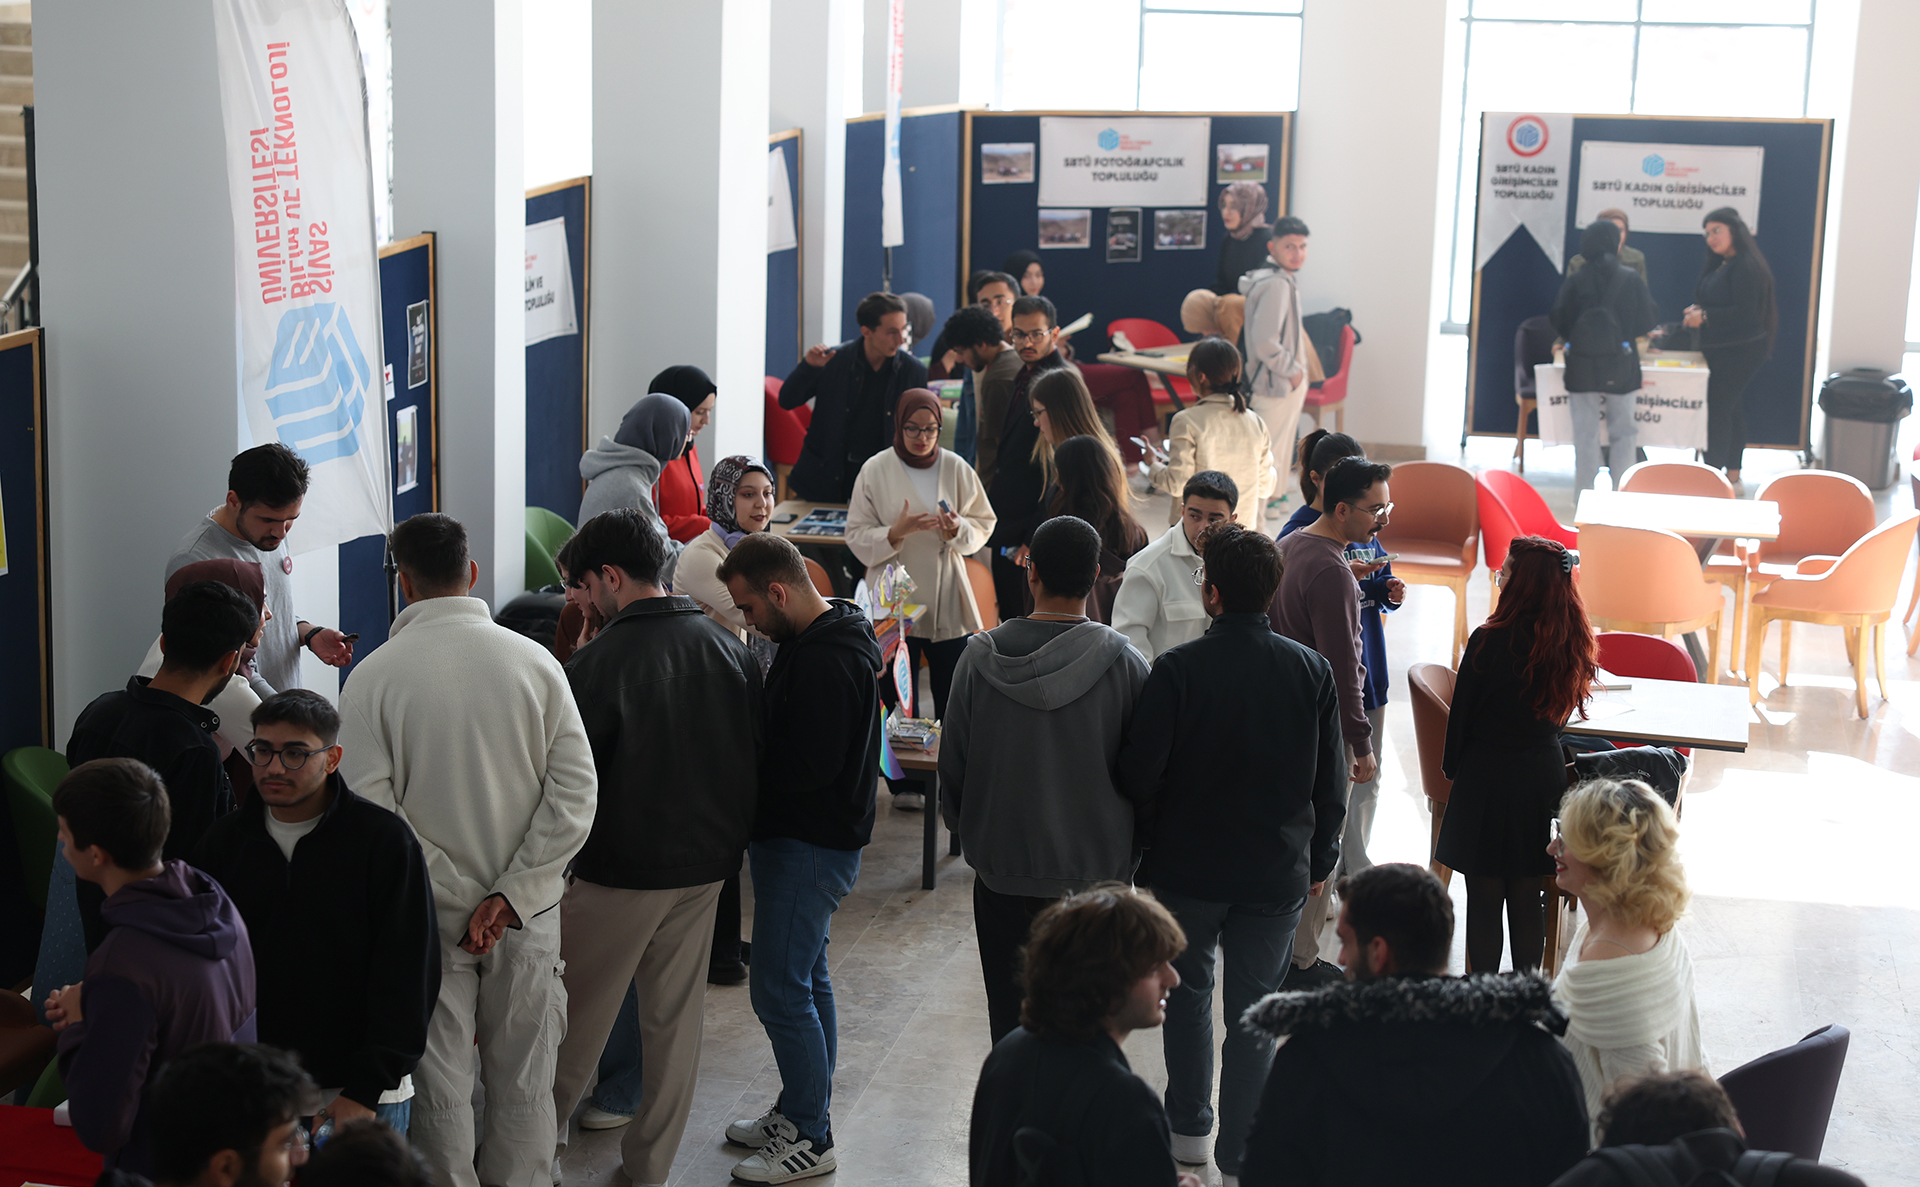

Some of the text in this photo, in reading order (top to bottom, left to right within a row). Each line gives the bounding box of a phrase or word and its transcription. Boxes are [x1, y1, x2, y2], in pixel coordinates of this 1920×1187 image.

[1063, 155, 1092, 168] SBTÜ
[1496, 162, 1555, 174] SBTÜ KADIN
[1091, 170, 1159, 182] TOPLULUĞU
[1592, 178, 1622, 191] SBTÜ
[1624, 180, 1662, 194] KADIN
[1494, 189, 1555, 200] TOPLULUĞU
[1632, 196, 1704, 210] TOPLULUĞU
[1550, 395, 1569, 406] SBT
